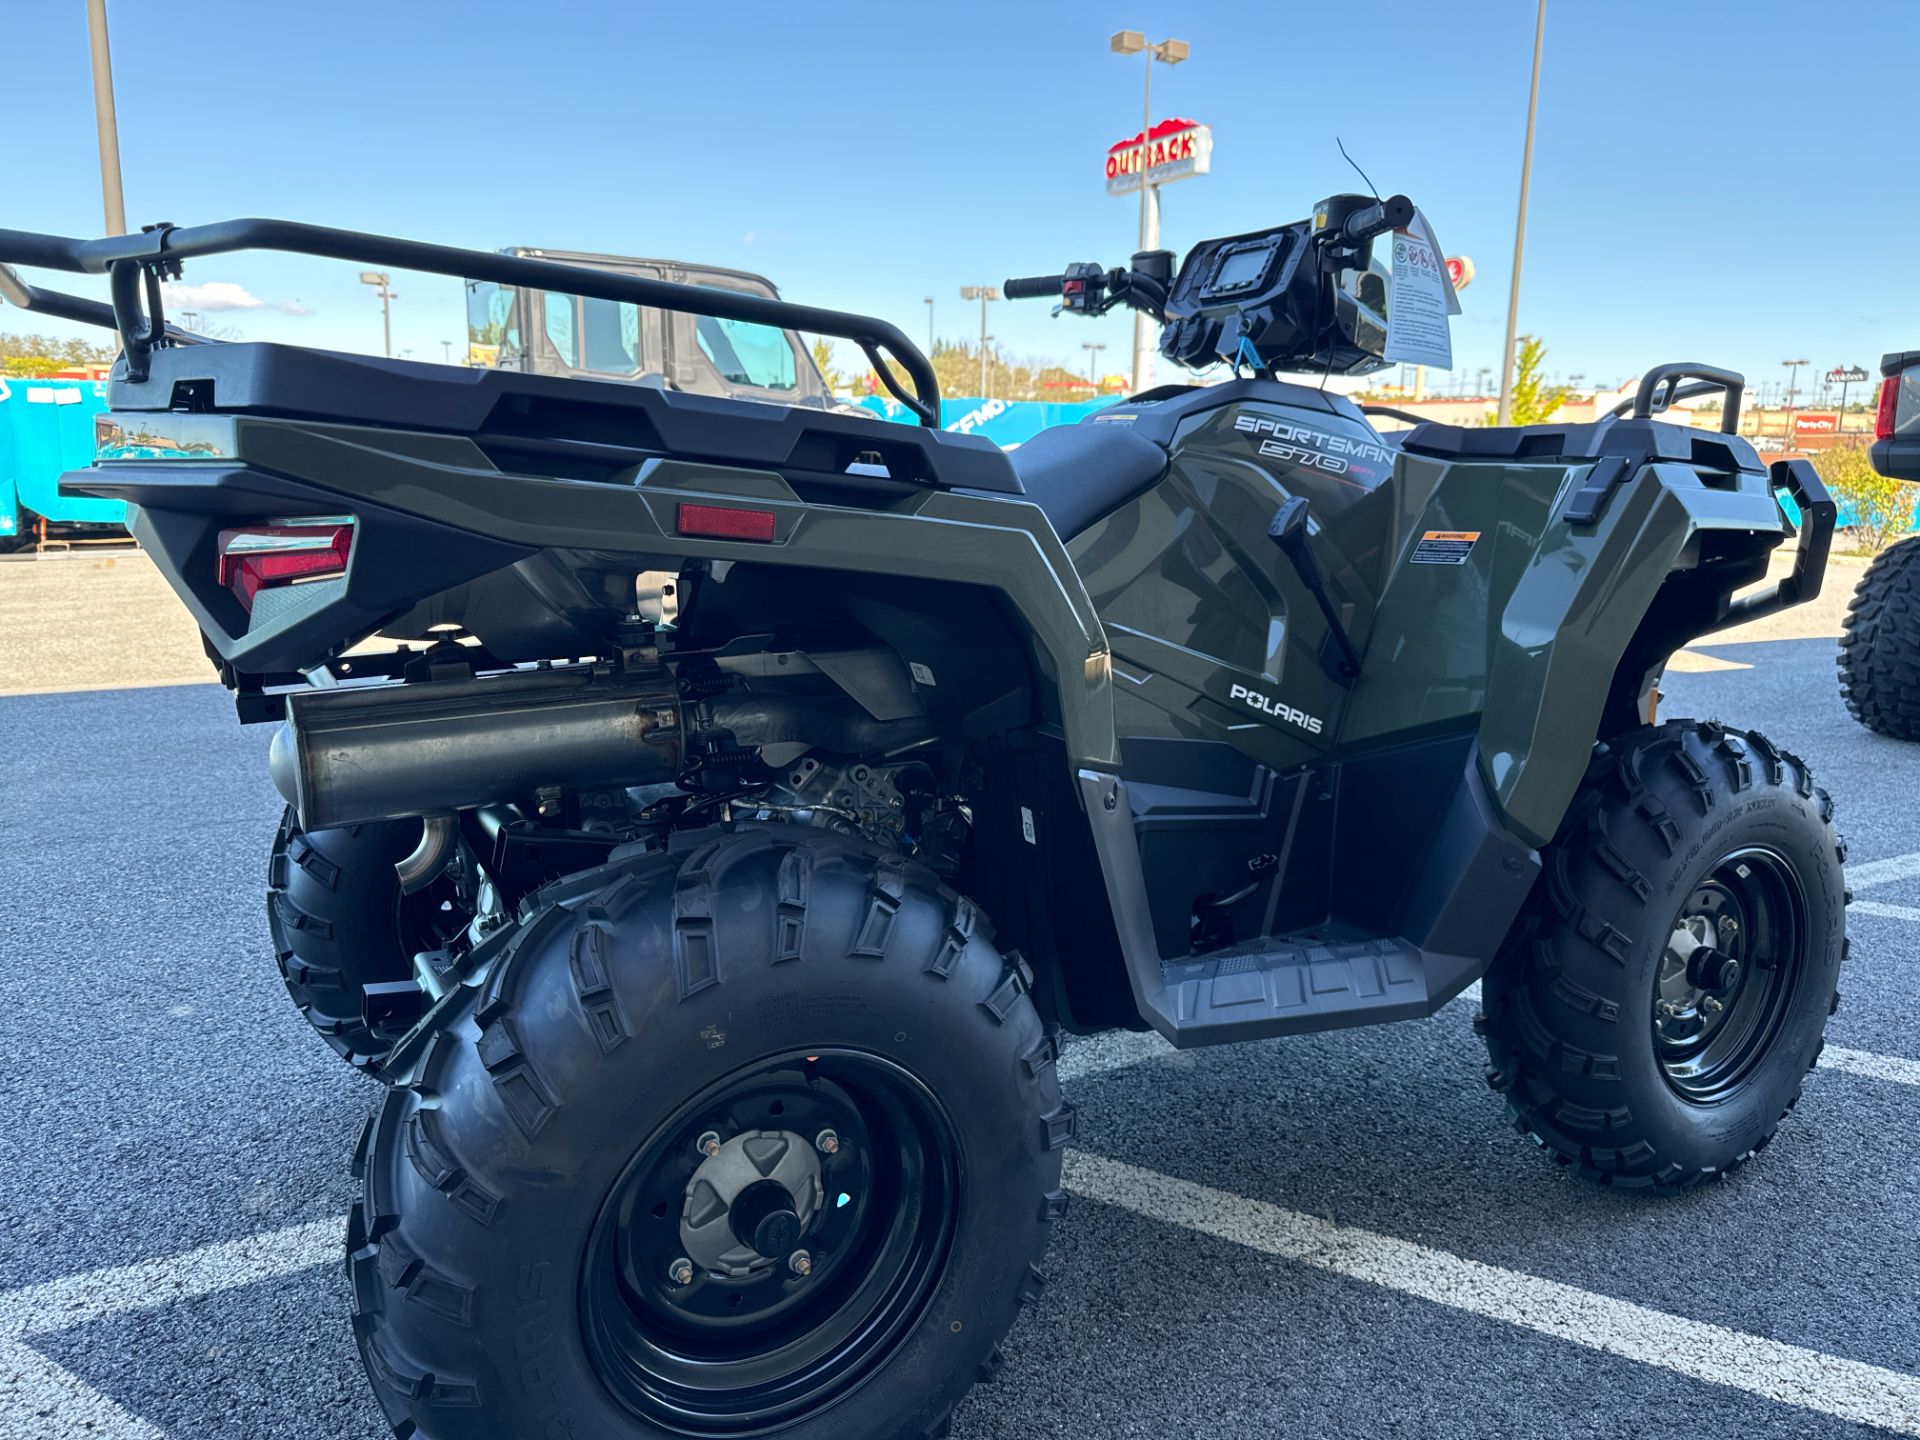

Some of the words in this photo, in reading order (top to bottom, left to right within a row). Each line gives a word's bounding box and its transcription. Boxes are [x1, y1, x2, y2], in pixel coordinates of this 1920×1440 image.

[944, 398, 1013, 434] FMO
[1234, 415, 1397, 466] SPORTSMAN
[1258, 439, 1349, 474] 570
[1229, 683, 1323, 734] POLARIS
[514, 1261, 585, 1440] OLARIS
